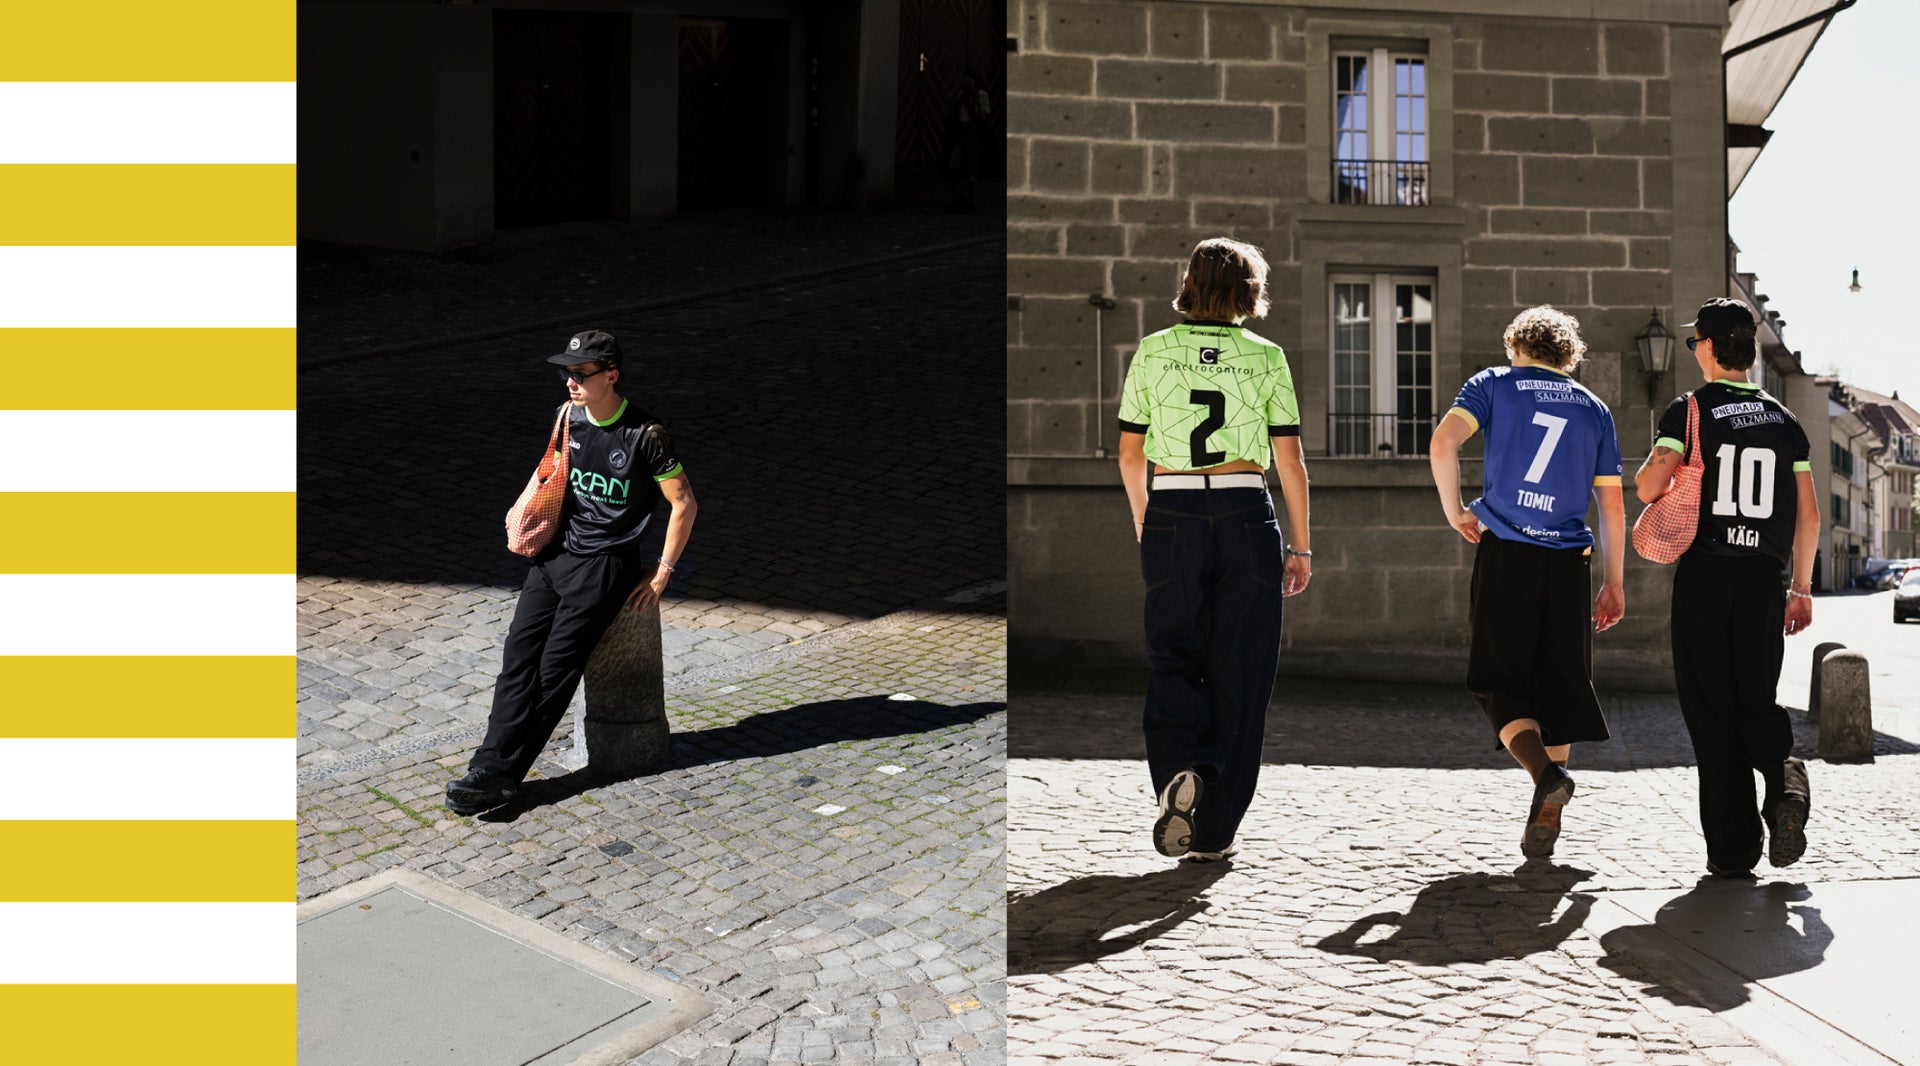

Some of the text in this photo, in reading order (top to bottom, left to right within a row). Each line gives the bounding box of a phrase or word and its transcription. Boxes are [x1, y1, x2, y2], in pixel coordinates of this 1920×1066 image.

[1163, 362, 1254, 377] electrocontrol
[1518, 381, 1571, 393] PNEUHAUS
[1536, 392, 1590, 406] SALZMANN
[1713, 402, 1762, 418] PNEUHAUS
[1190, 388, 1226, 468] 2
[1732, 412, 1782, 429] SALZMANN
[1523, 411, 1568, 484] 7
[1712, 443, 1776, 519] 10
[590, 495, 607, 503] next
[609, 497, 627, 505] level
[1517, 489, 1556, 513] TOMIC
[1727, 525, 1760, 548] KÄGI
